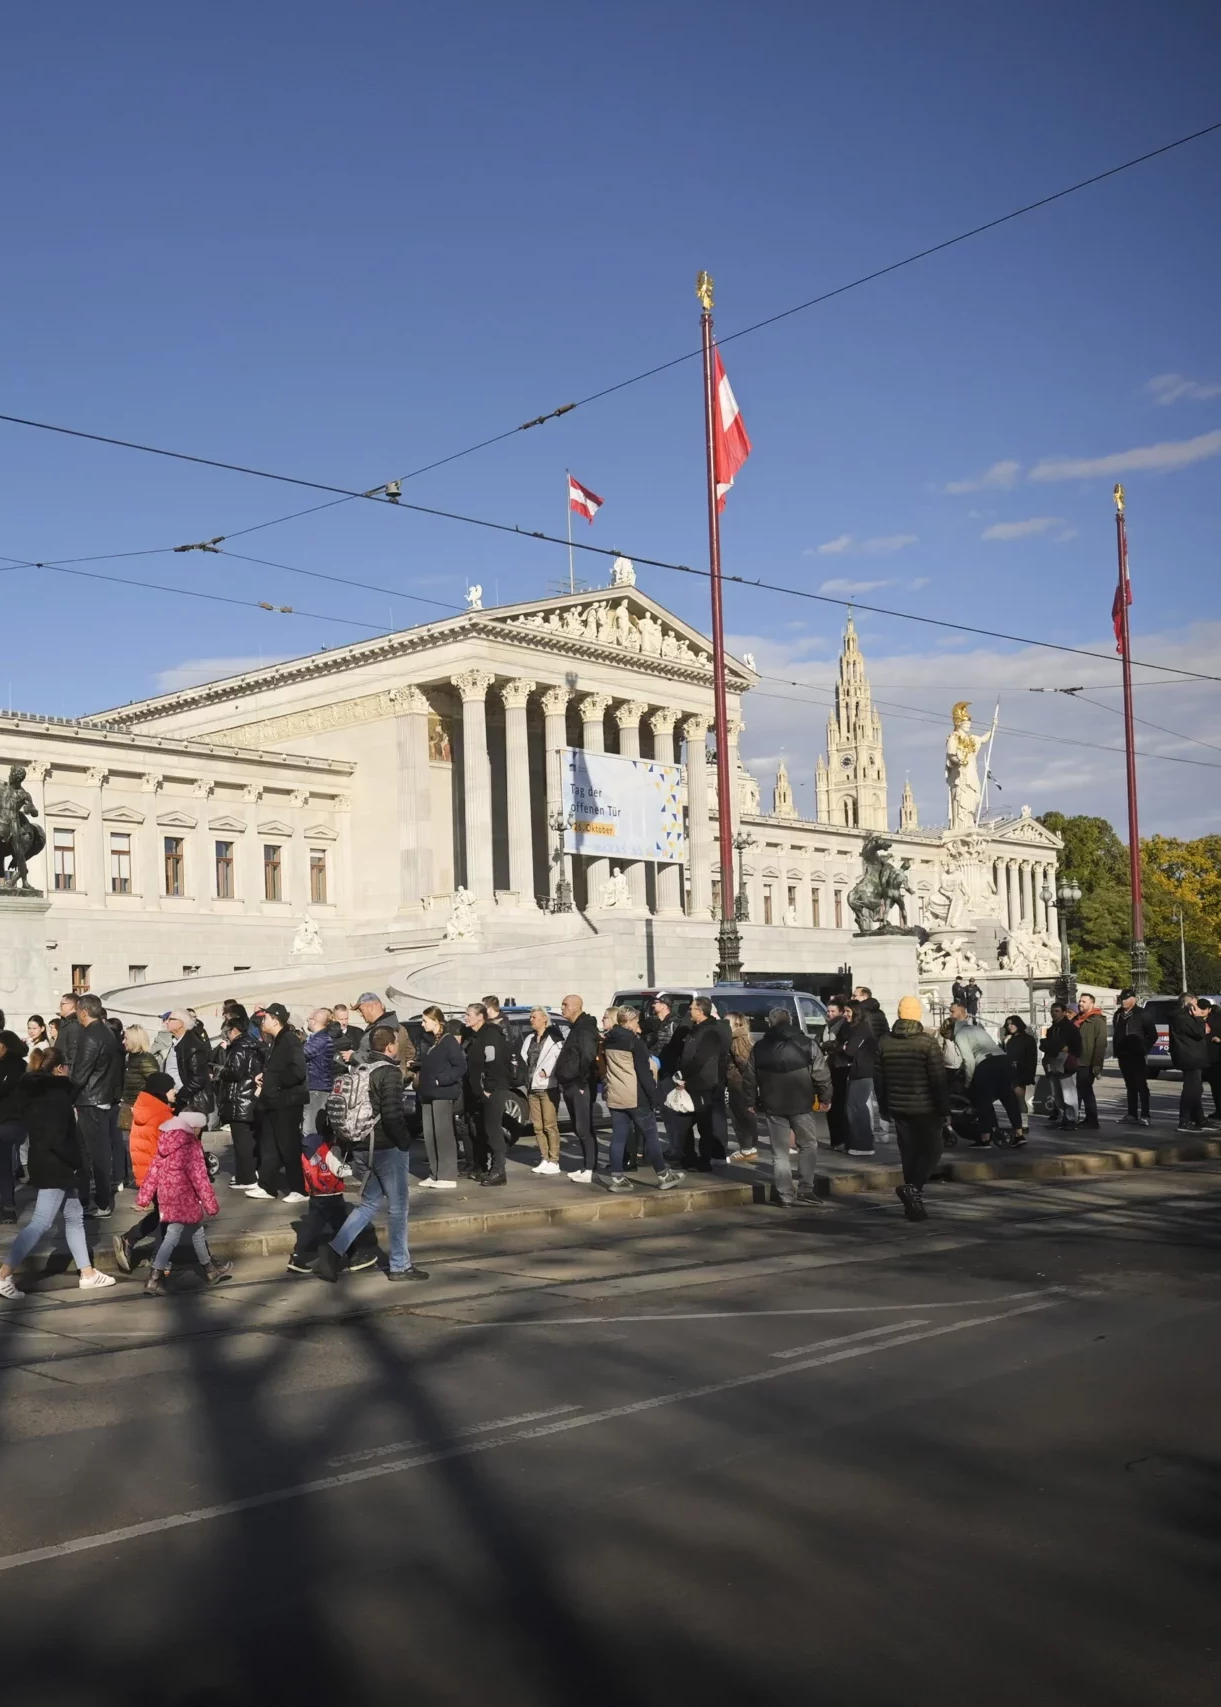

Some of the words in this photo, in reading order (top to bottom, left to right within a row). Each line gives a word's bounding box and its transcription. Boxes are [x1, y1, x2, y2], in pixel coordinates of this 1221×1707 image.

[570, 784, 585, 798] Tag
[588, 786, 602, 798] der
[571, 802, 604, 816] offenen
[607, 806, 621, 817] Tür
[586, 824, 613, 835] Oktober
